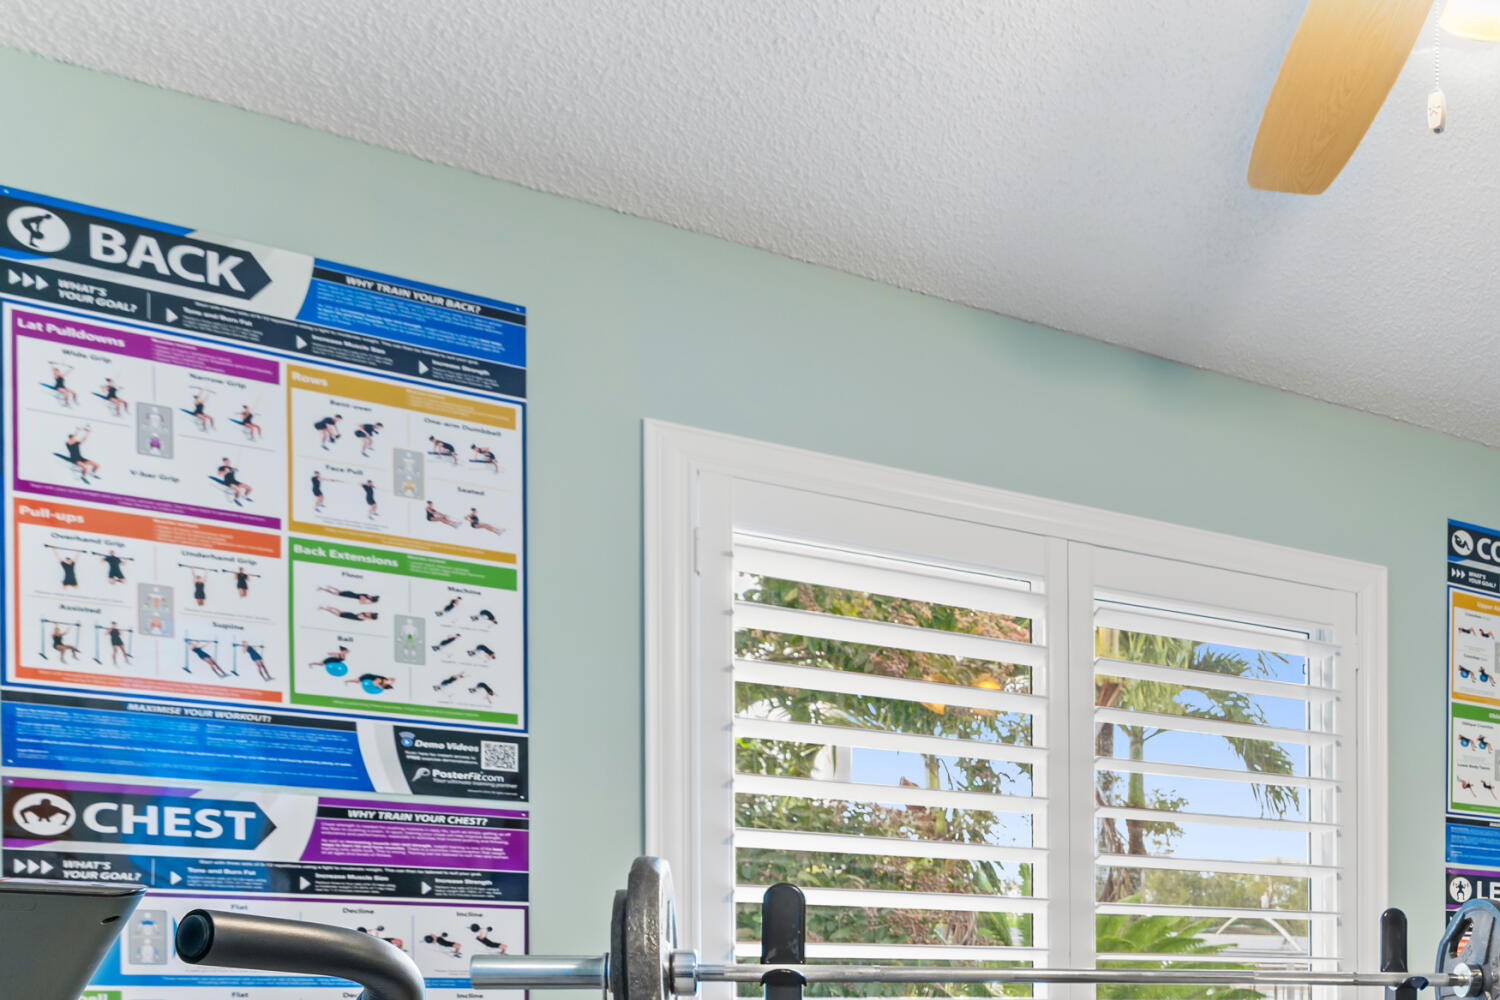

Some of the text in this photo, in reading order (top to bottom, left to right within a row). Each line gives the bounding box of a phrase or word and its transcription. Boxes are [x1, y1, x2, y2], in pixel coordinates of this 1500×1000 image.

[89, 223, 245, 292] BACK
[57, 278, 107, 296] WHAT'S
[346, 276, 482, 314] WHY TRAIN YOUR BACK?
[58, 289, 138, 314] YOUR GOAL?
[183, 306, 202, 317] Tone
[219, 315, 238, 325] Burn
[239, 319, 253, 327] Fat
[17, 318, 126, 348] Lat Pulldowns
[62, 349, 112, 364] Wide Grip
[226, 380, 246, 390] Grip
[291, 371, 329, 387] Rows
[159, 474, 180, 484] Grip
[347, 467, 364, 476] Pull
[457, 487, 485, 496] Seated
[19, 504, 85, 524] Pull-ups
[51, 531, 126, 549] Overhand Grip
[181, 549, 258, 567] Underhand Grip
[293, 544, 399, 567] Back Extensions
[1468, 571, 1486, 579] WHAT'S
[1468, 577, 1496, 588] YOUR GOAL?
[1477, 602, 1493, 610] Upper
[337, 635, 354, 643] Ball
[126, 703, 272, 723] MAXIMISE YOUR WORKOUT!
[414, 740, 479, 752] Demo Videos
[83, 802, 256, 841] CHEST
[348, 810, 488, 826] WHY TRAIN YOUR CHEST?
[63, 860, 112, 870] WHAT'S
[63, 871, 141, 882] YOUR GOAL?
